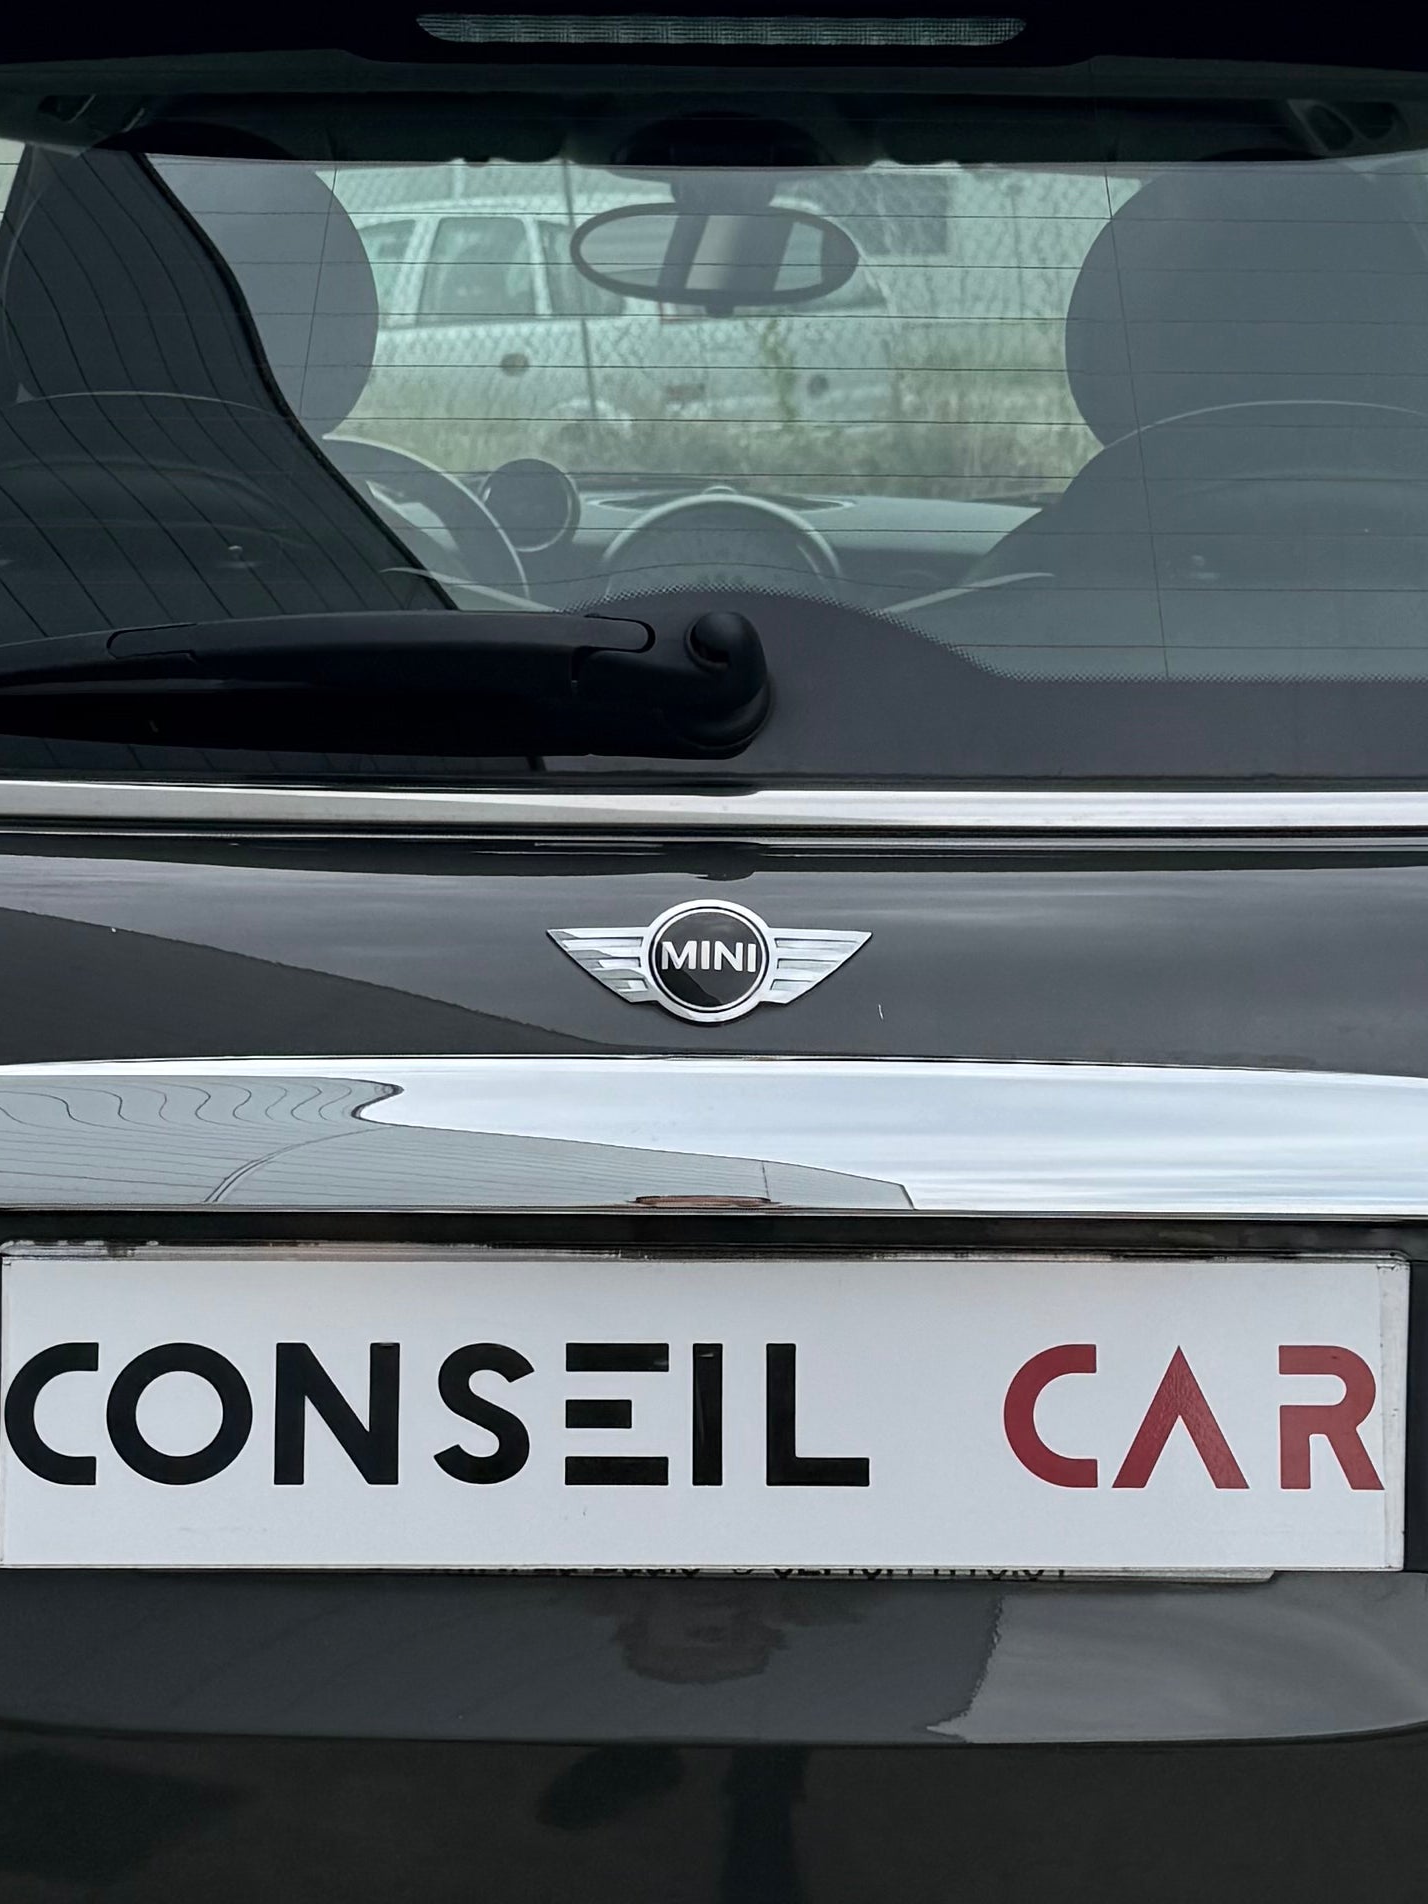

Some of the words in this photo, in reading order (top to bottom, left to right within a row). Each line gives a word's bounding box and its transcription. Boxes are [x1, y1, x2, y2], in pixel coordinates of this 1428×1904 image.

[661, 940, 757, 973] MINI
[3, 1342, 870, 1486] CONSEIL
[1004, 1343, 1385, 1489] CAR
